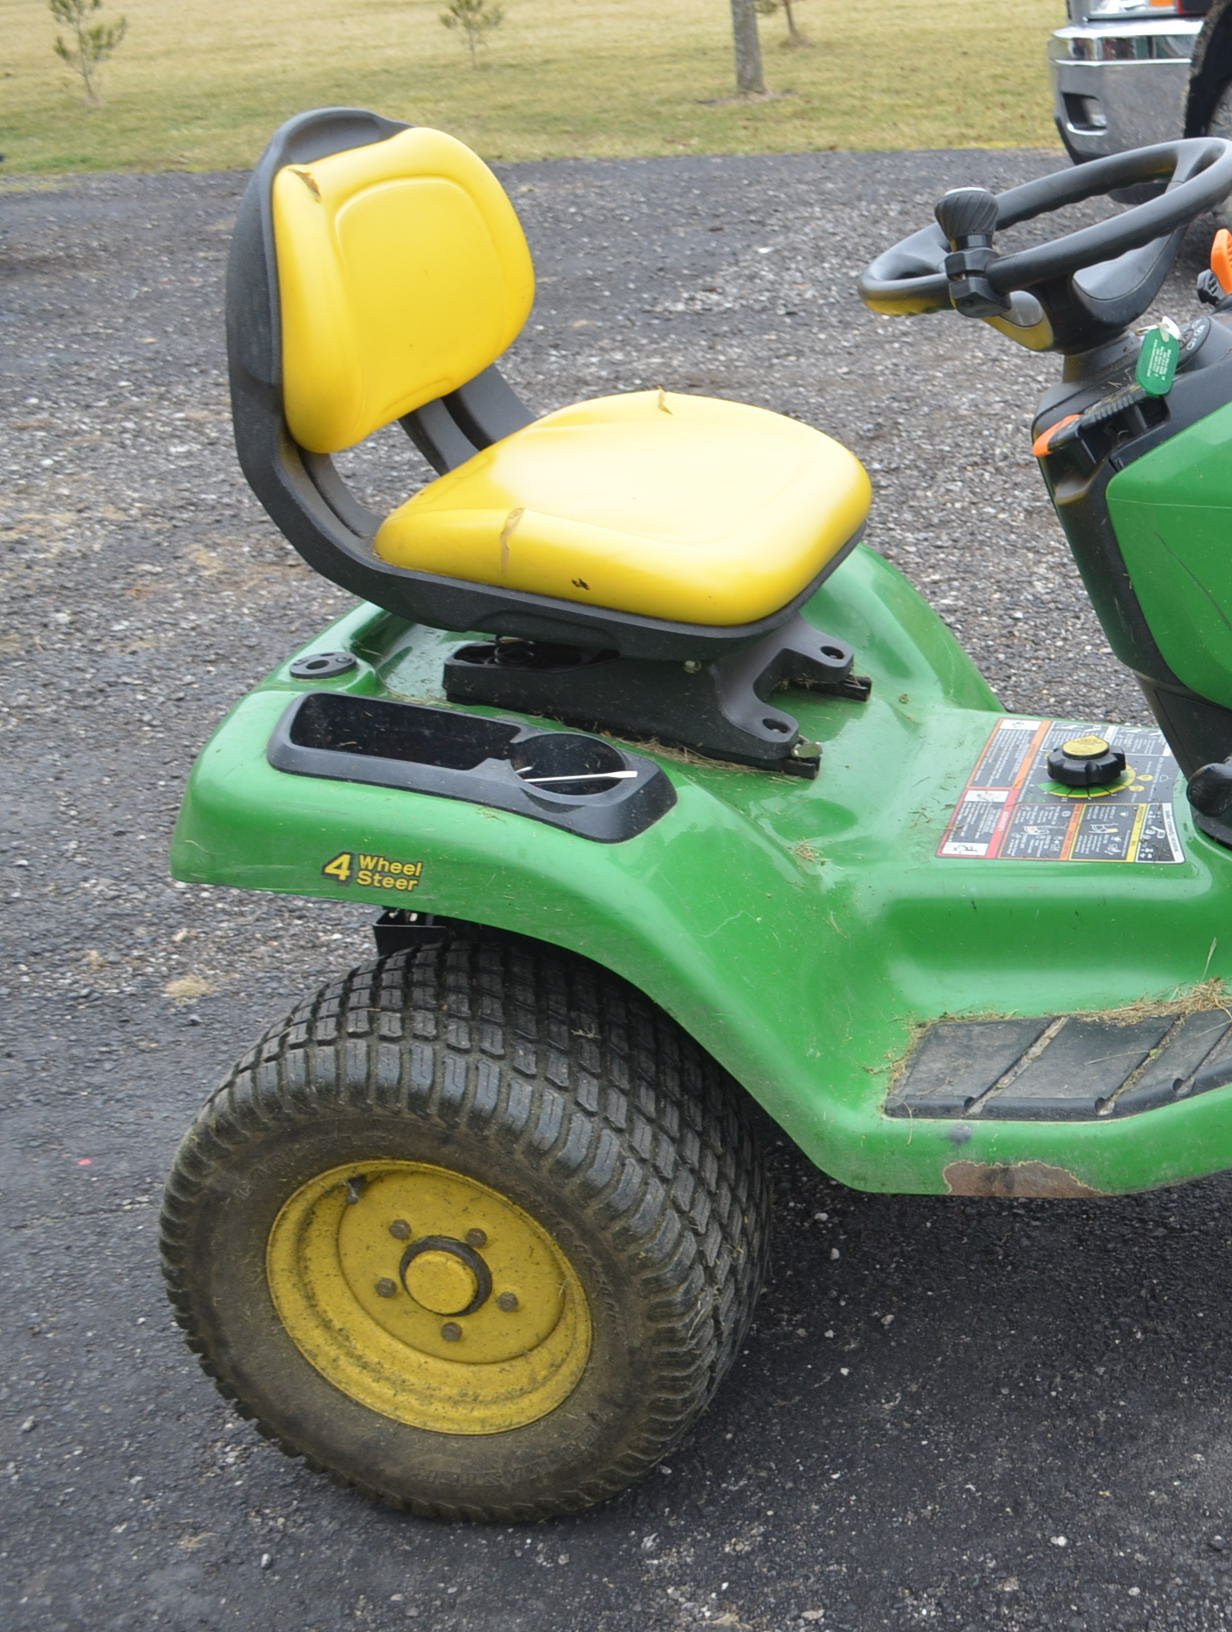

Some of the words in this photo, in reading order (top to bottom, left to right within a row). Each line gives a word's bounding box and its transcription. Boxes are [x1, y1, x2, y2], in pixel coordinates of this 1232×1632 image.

[322, 852, 354, 883] 4
[358, 853, 423, 877] Wheel
[356, 869, 419, 892] Steer
